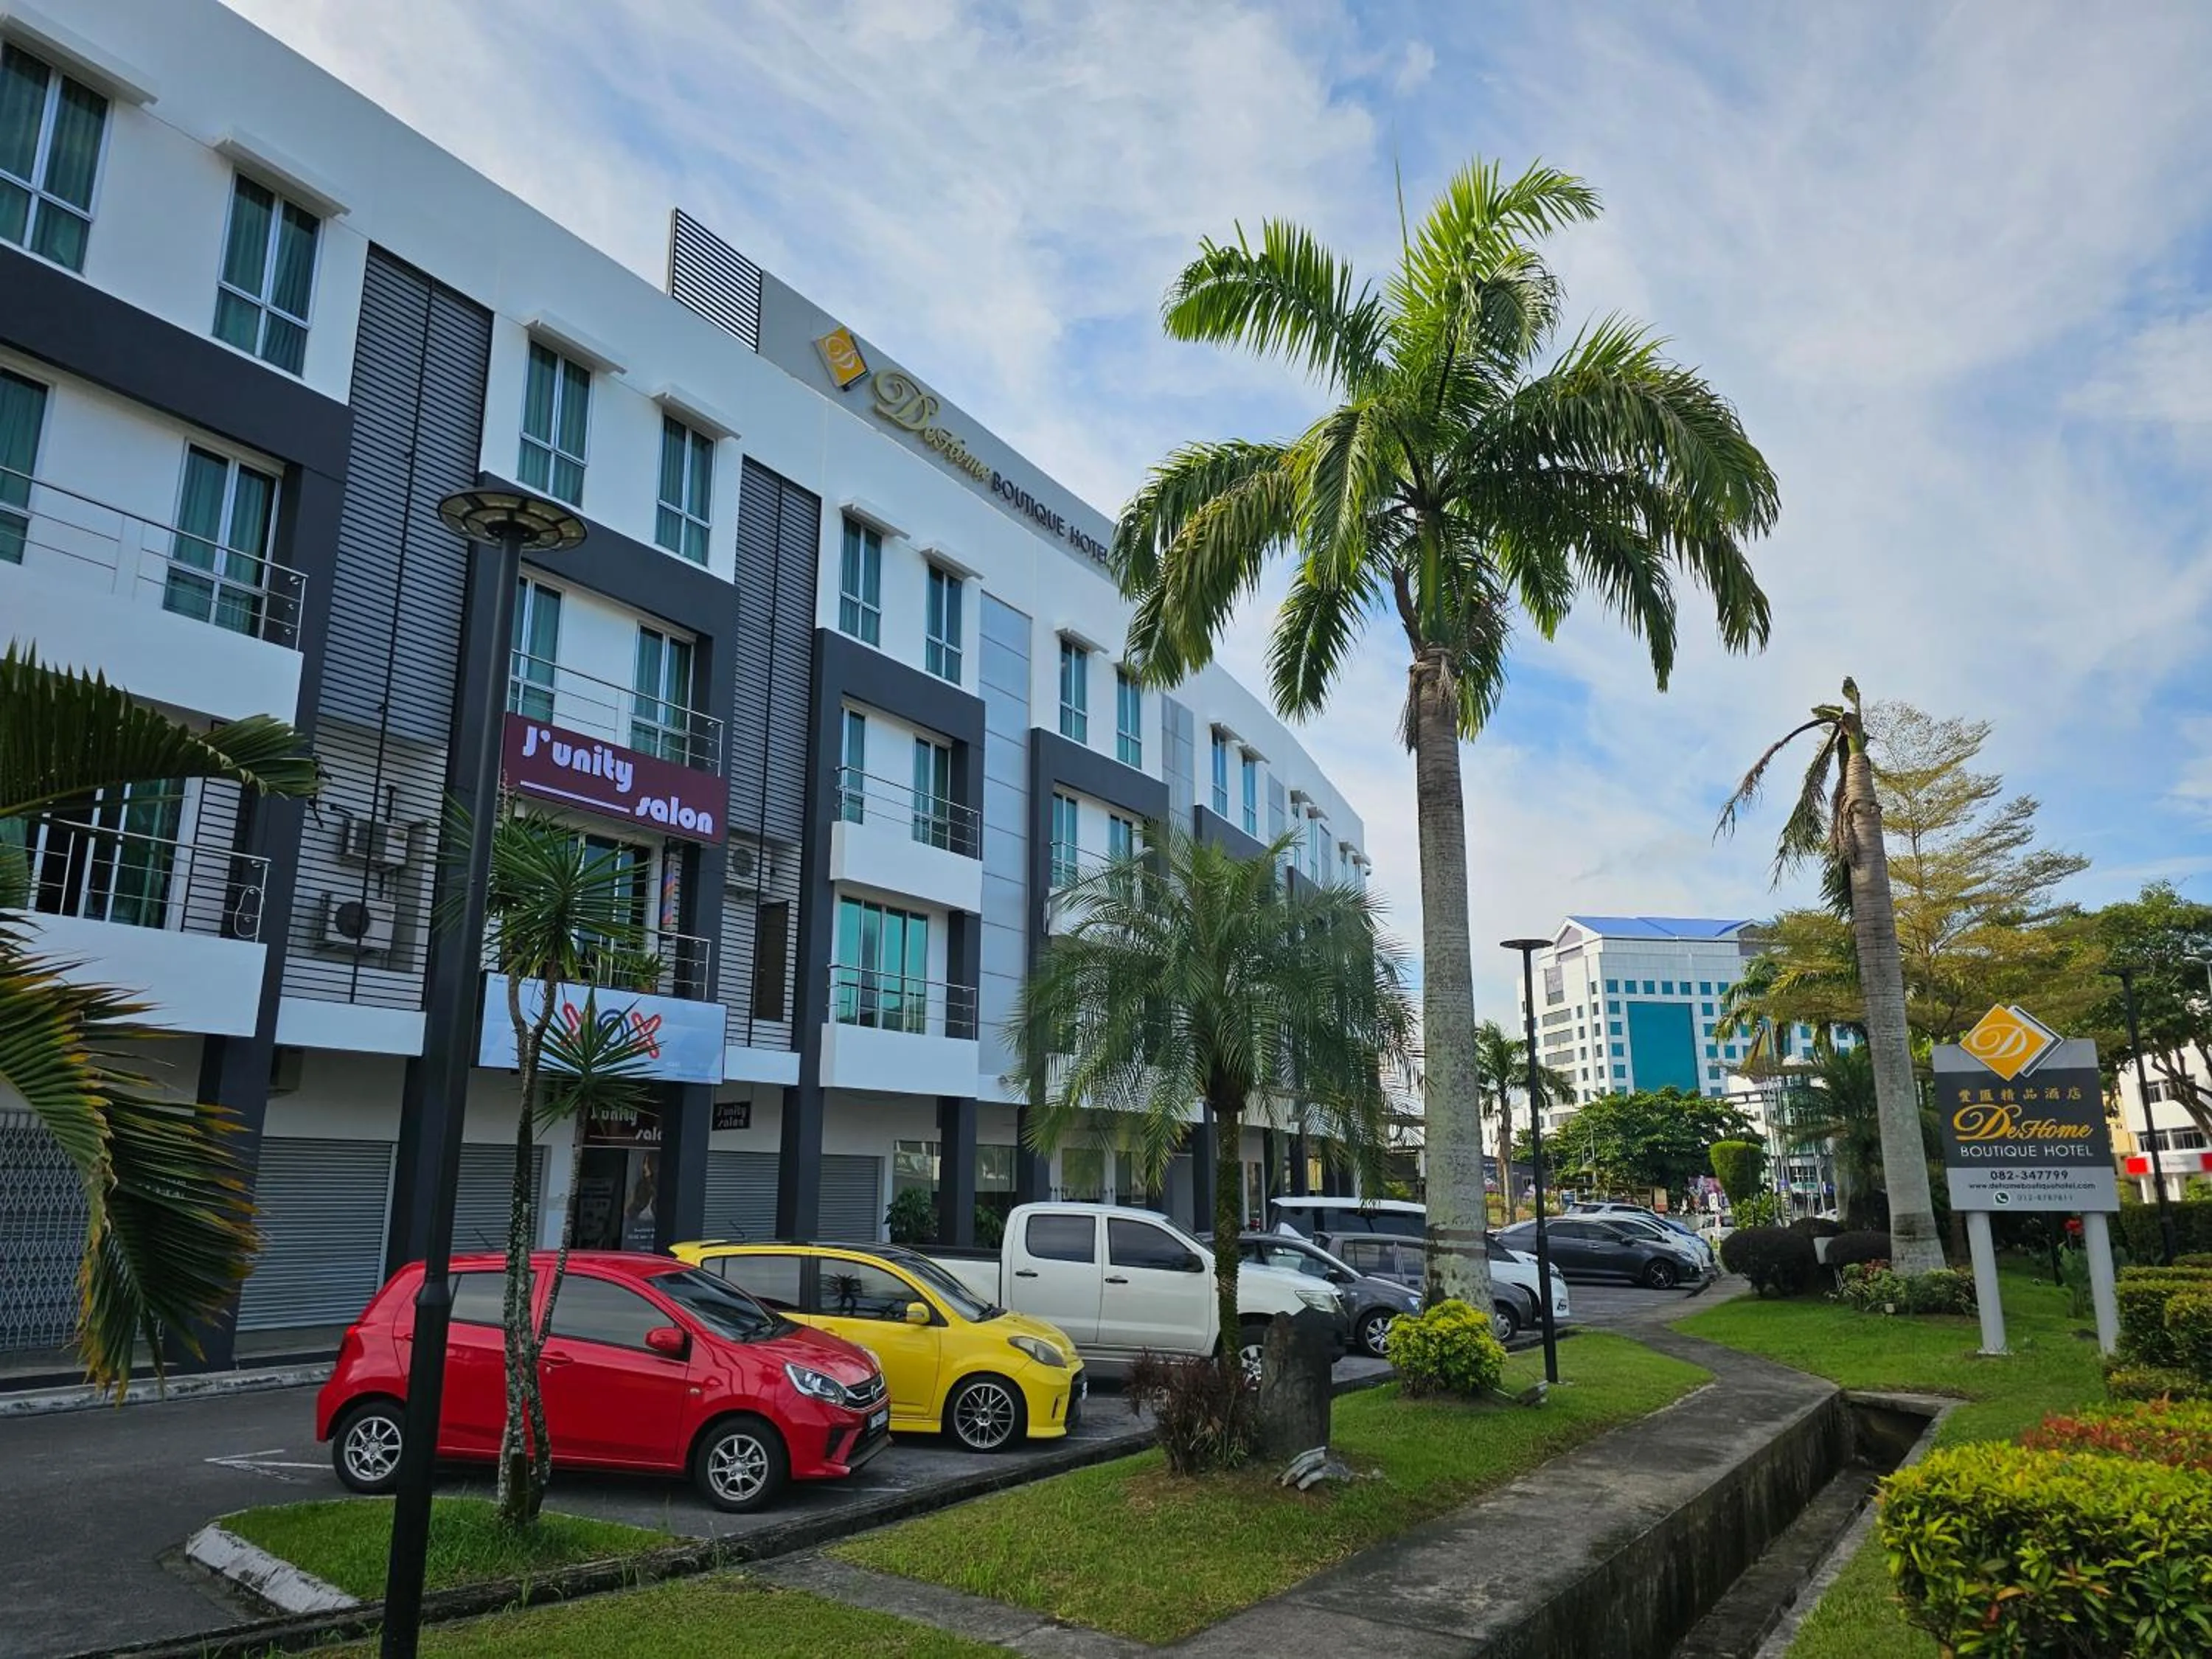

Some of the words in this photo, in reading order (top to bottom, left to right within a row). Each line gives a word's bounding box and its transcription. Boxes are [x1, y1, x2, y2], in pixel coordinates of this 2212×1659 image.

[990, 471, 1065, 538] BOUTIQUE
[522, 725, 633, 793] J'unity
[635, 796, 713, 835] salon
[1971, 1023, 2027, 1060] D
[1961, 1145, 2037, 1157] BOUTIQUE
[2045, 1144, 2093, 1157] HOTEL
[1990, 1170, 2069, 1180] 082-347799
